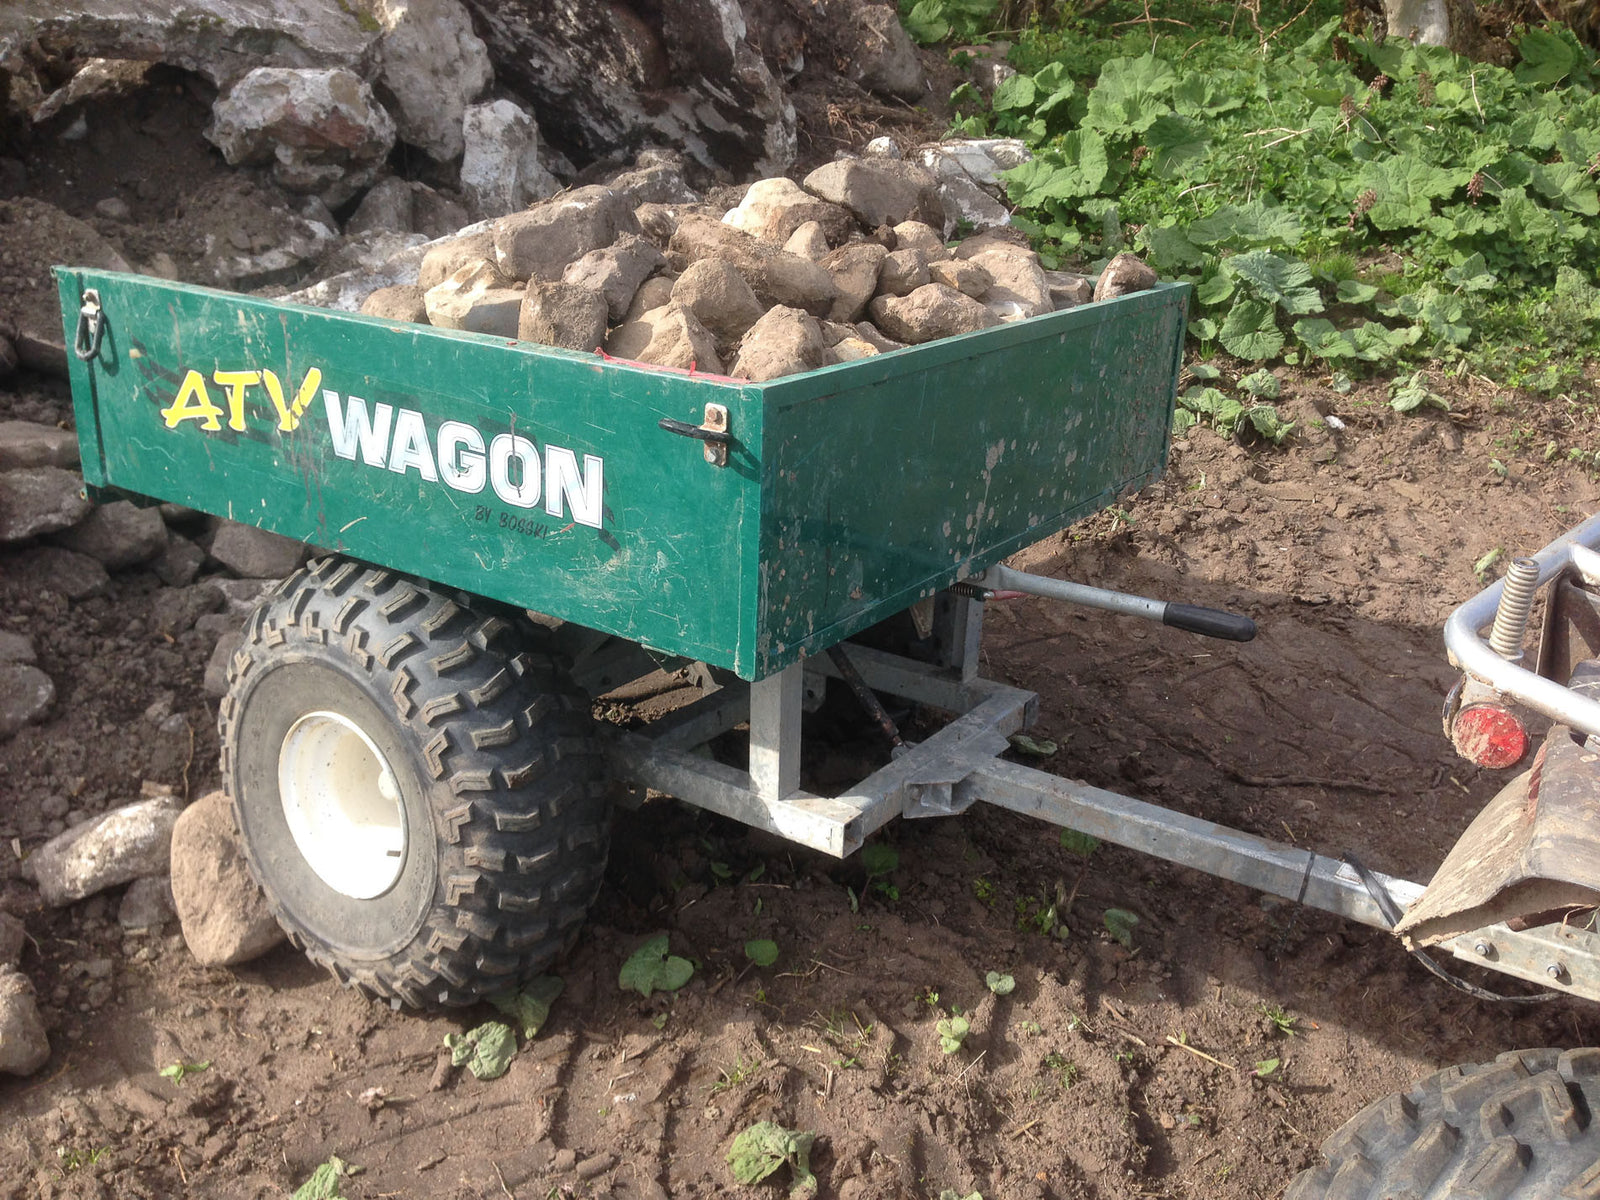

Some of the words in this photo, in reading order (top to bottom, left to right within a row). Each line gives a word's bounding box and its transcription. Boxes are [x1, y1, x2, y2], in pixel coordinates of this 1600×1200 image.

[160, 367, 322, 432] ATV
[322, 390, 604, 530] WAGON
[475, 505, 492, 523] BY
[500, 512, 548, 540] BOSSKI
